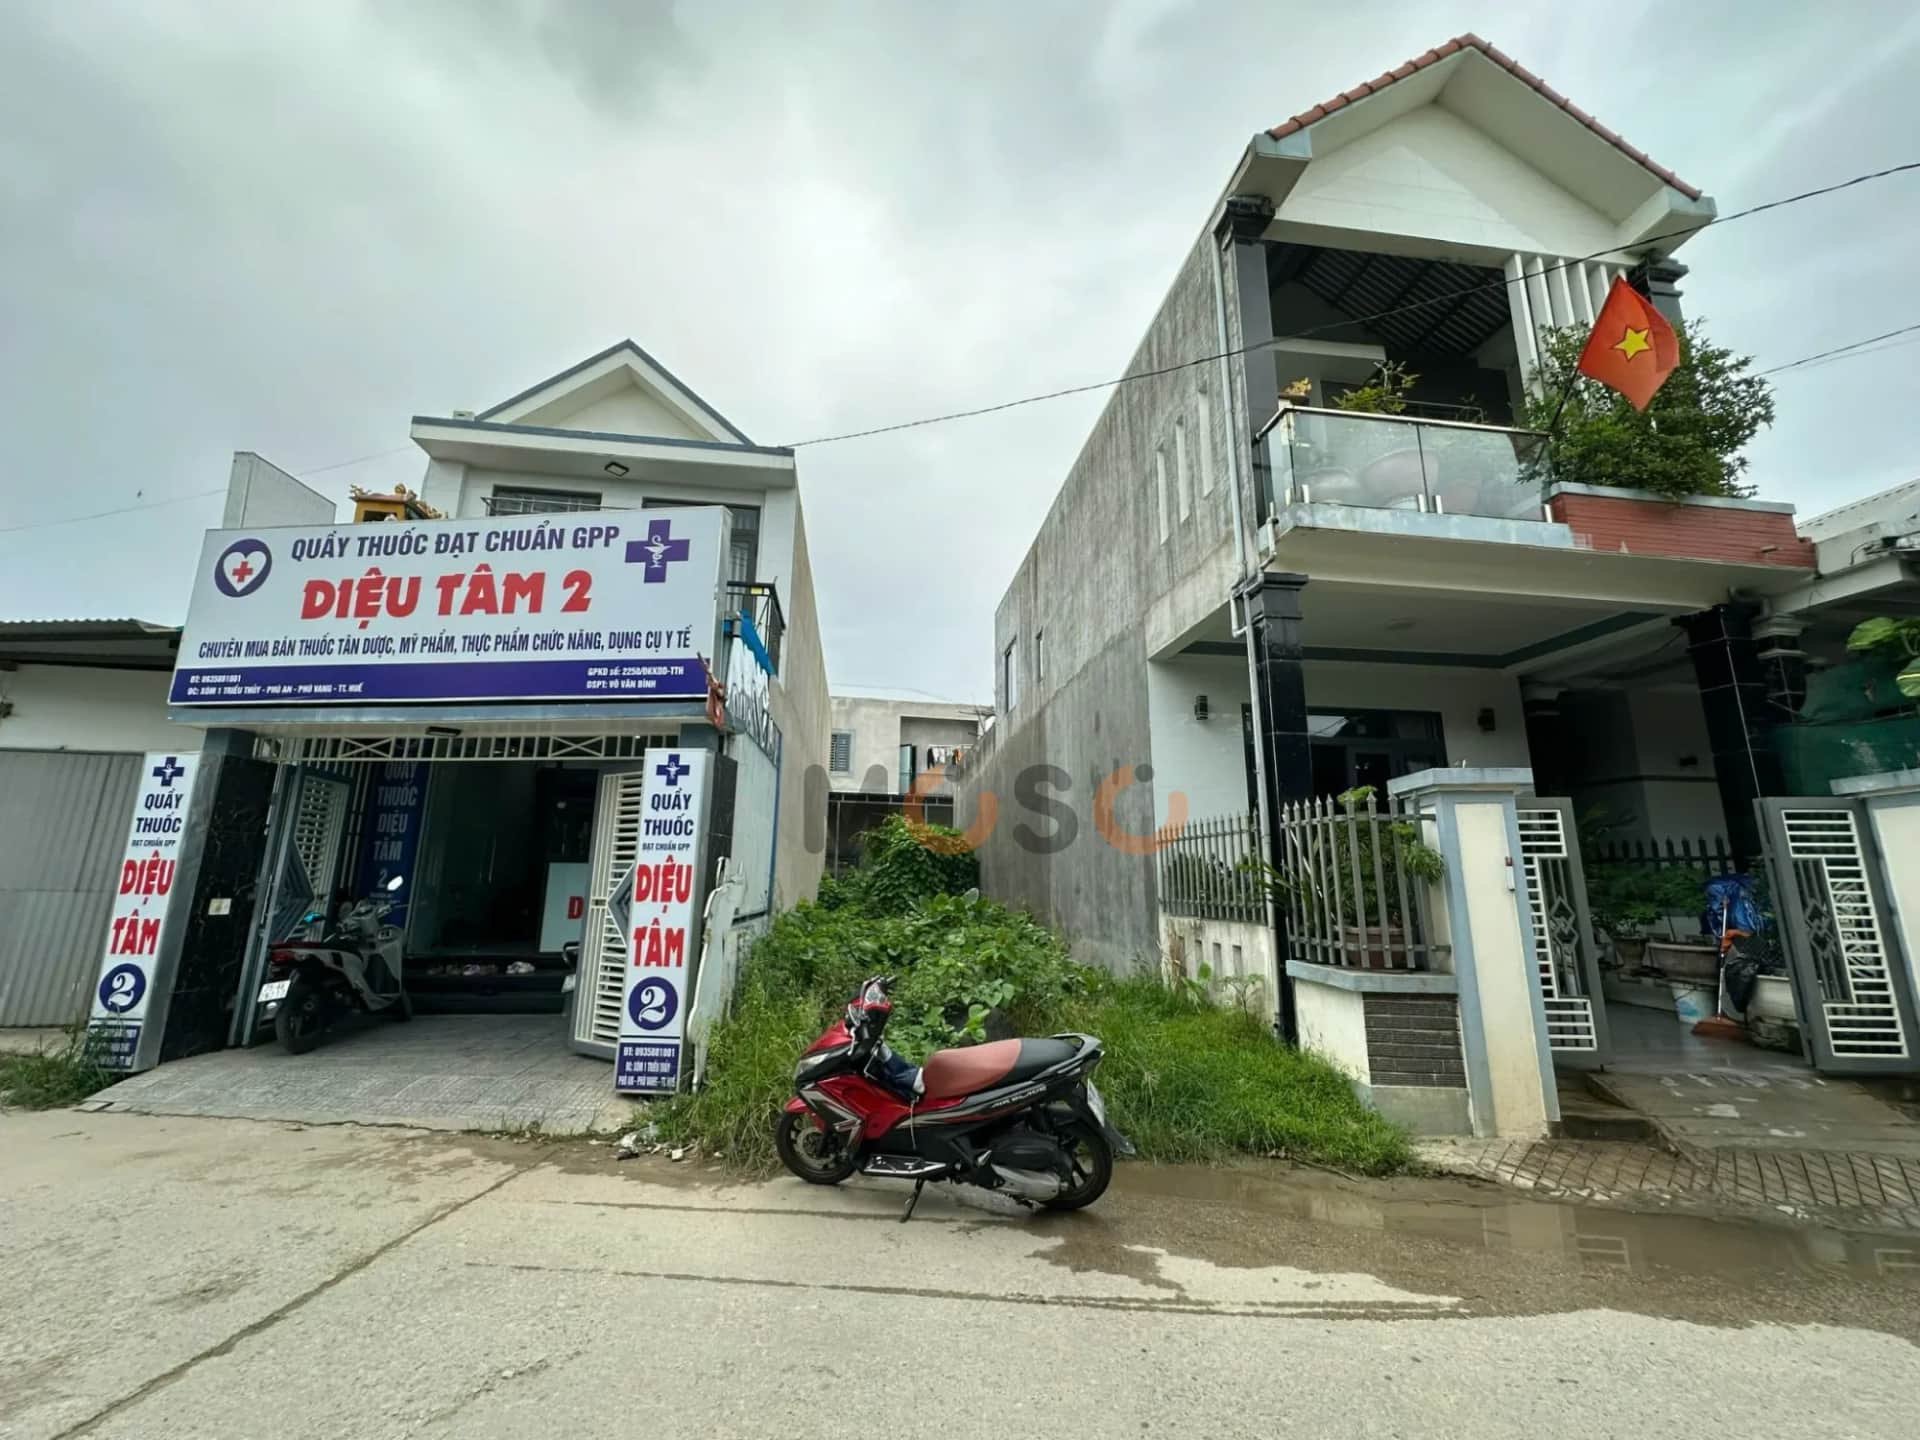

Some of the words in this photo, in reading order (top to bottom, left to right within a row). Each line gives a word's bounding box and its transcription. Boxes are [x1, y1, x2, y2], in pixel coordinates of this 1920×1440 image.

[357, 527, 429, 557] THUỐC
[434, 532, 479, 558] ĐẠT
[485, 519, 565, 552] CHUẨN
[572, 526, 619, 549] GPP
[300, 565, 421, 629] DIỆU
[436, 563, 545, 616] TÂM
[560, 569, 592, 612] 2
[199, 637, 243, 658] CHUYÊN
[245, 640, 269, 657] MUA
[271, 635, 296, 656] BÁN
[299, 632, 335, 656] THUỐC
[338, 634, 360, 655] TÂN
[362, 635, 395, 658] DƯỢC,
[399, 633, 418, 654] MỸ
[420, 628, 457, 654] PHẨM,
[462, 633, 491, 656] THỰC
[494, 626, 529, 652] PHẨM
[532, 629, 565, 651] CHỨC
[567, 629, 604, 652] NĂNG,
[608, 631, 642, 653] DỤNG
[645, 631, 662, 653] CỤ
[665, 630, 673, 648] Y
[676, 624, 692, 648] TẾ
[377, 779, 418, 806] THUỐC
[136, 811, 182, 833] THUỐC
[376, 809, 409, 837] DIỆU
[644, 813, 694, 836] THUỐC
[372, 837, 403, 861] TÂM
[119, 850, 176, 905] DIỆU
[377, 868, 388, 889] 2
[634, 855, 693, 914] DIỆU
[109, 909, 161, 955] TÂM
[632, 918, 685, 968] TÂM
[108, 972, 136, 1006] 2
[638, 988, 667, 1023] 2
